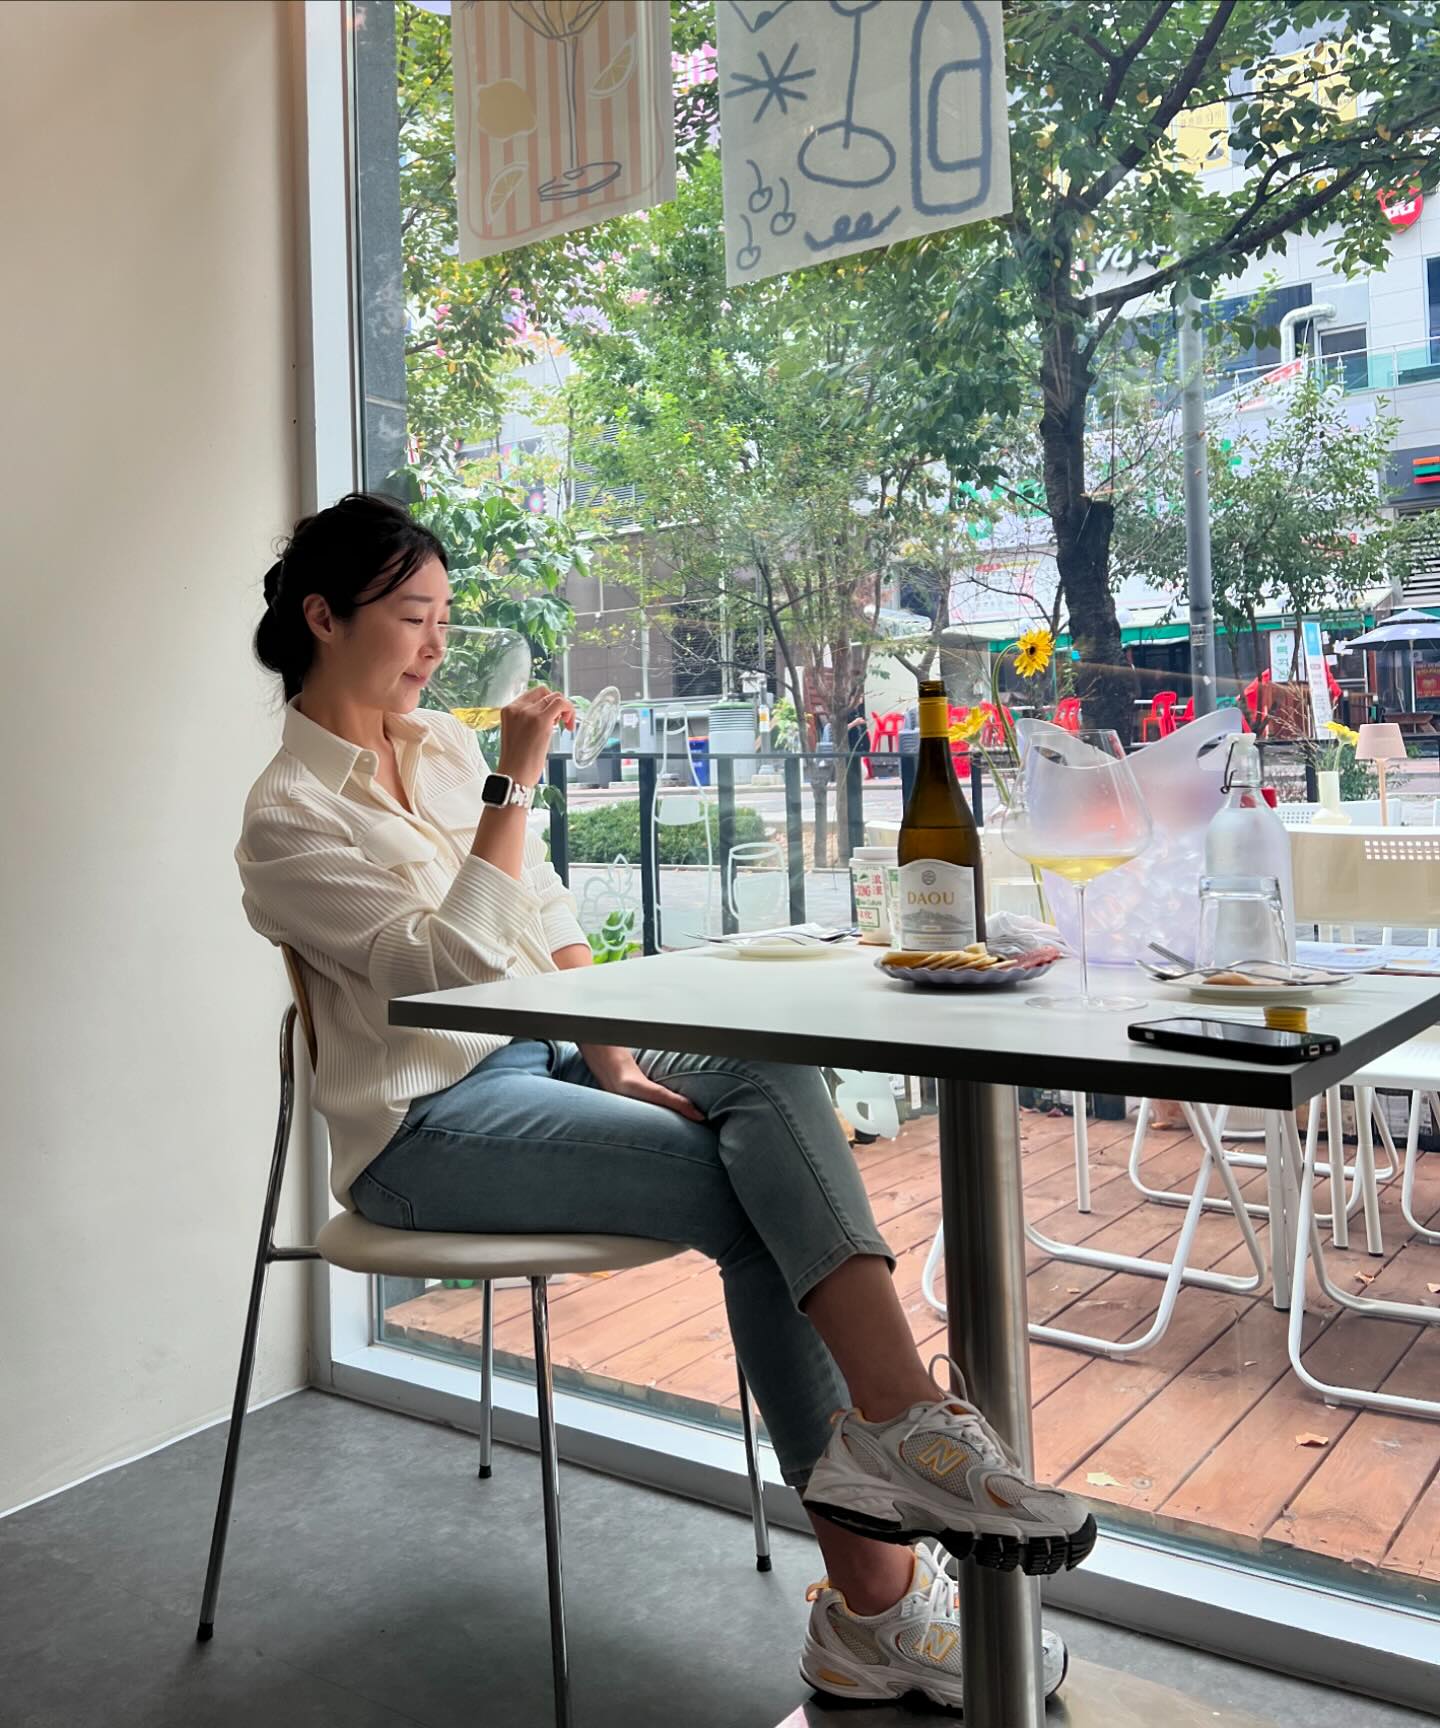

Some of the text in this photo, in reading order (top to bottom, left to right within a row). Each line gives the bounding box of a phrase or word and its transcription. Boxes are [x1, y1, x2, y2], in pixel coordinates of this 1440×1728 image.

[906, 891, 955, 906] DAOU
[918, 1438, 967, 1477] N
[914, 1624, 958, 1663] N
